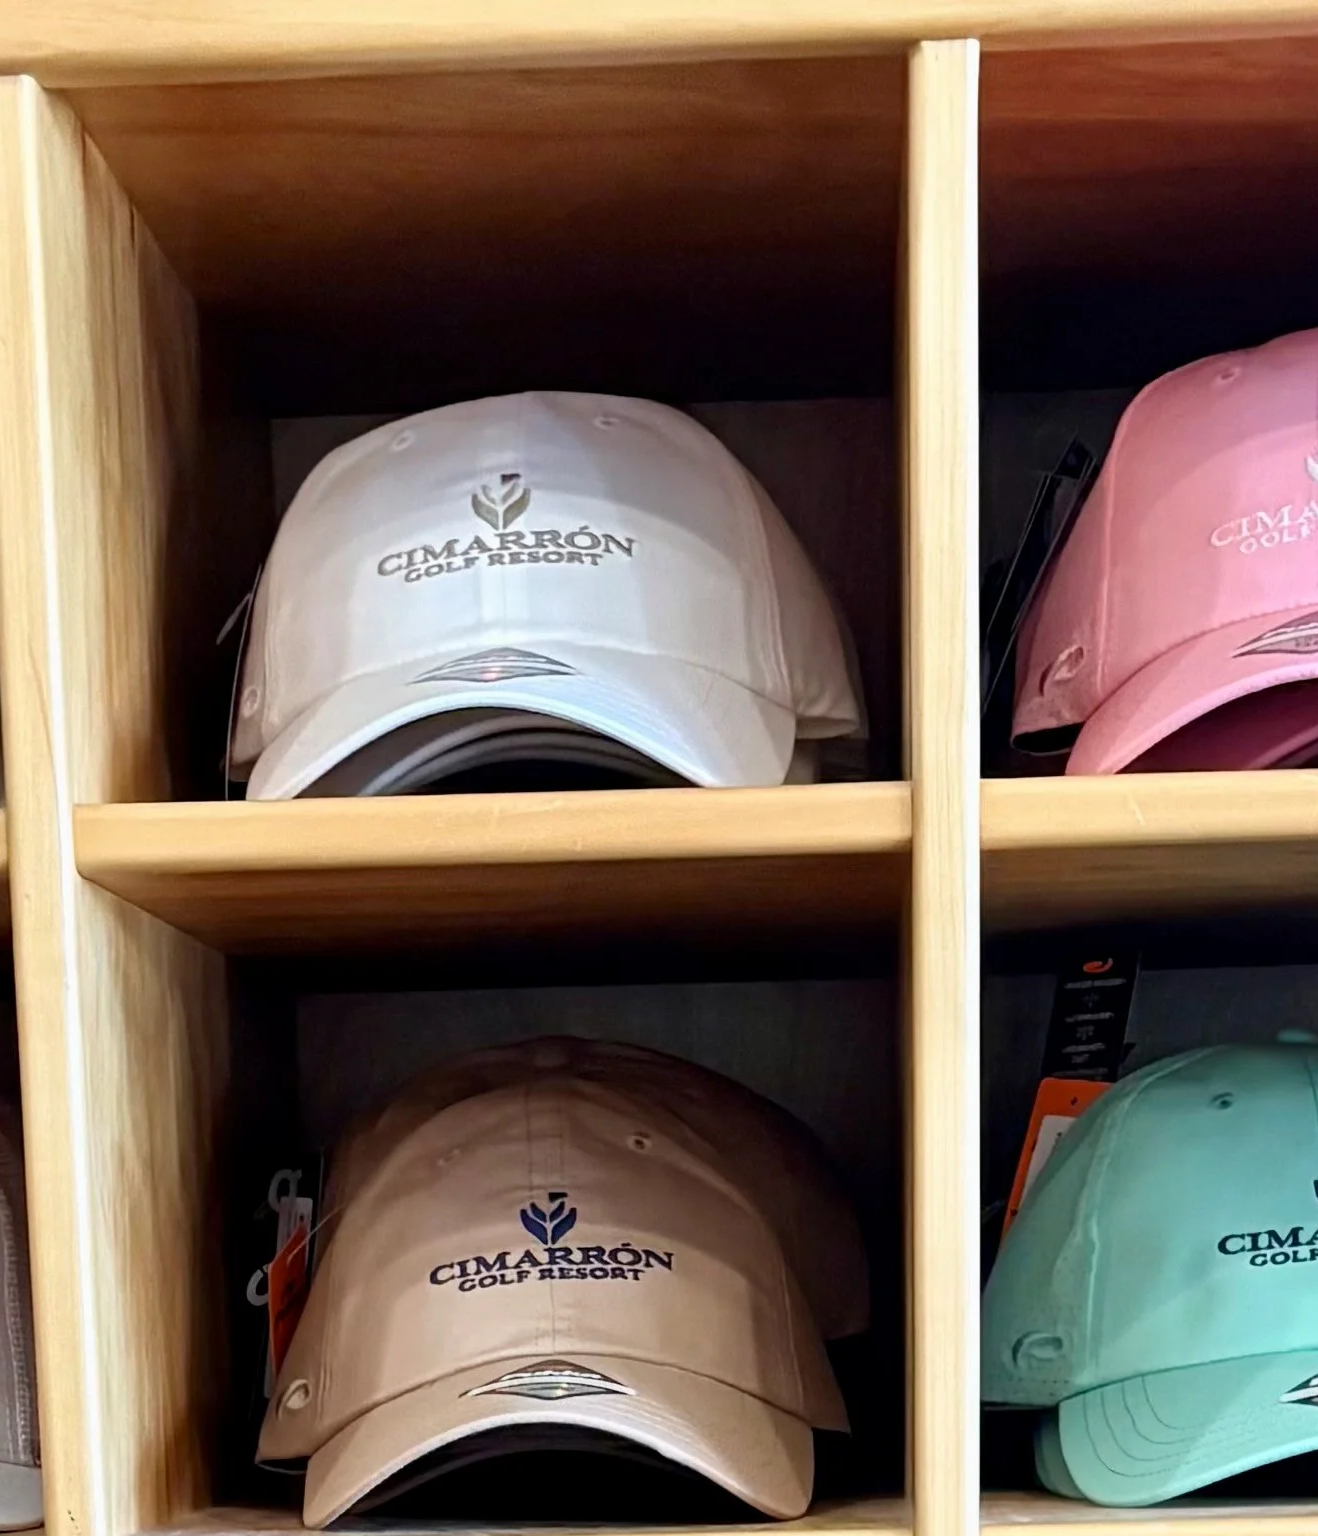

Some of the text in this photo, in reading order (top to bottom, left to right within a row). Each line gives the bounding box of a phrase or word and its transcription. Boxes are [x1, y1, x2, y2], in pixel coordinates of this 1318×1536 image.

[376, 525, 641, 577] CIMARRÓN
[1239, 526, 1313, 556] GOLF
[403, 548, 604, 585] GOLF RESORT
[429, 1243, 675, 1287] CIMARRÓN
[459, 1265, 646, 1291] GOLF RESORT
